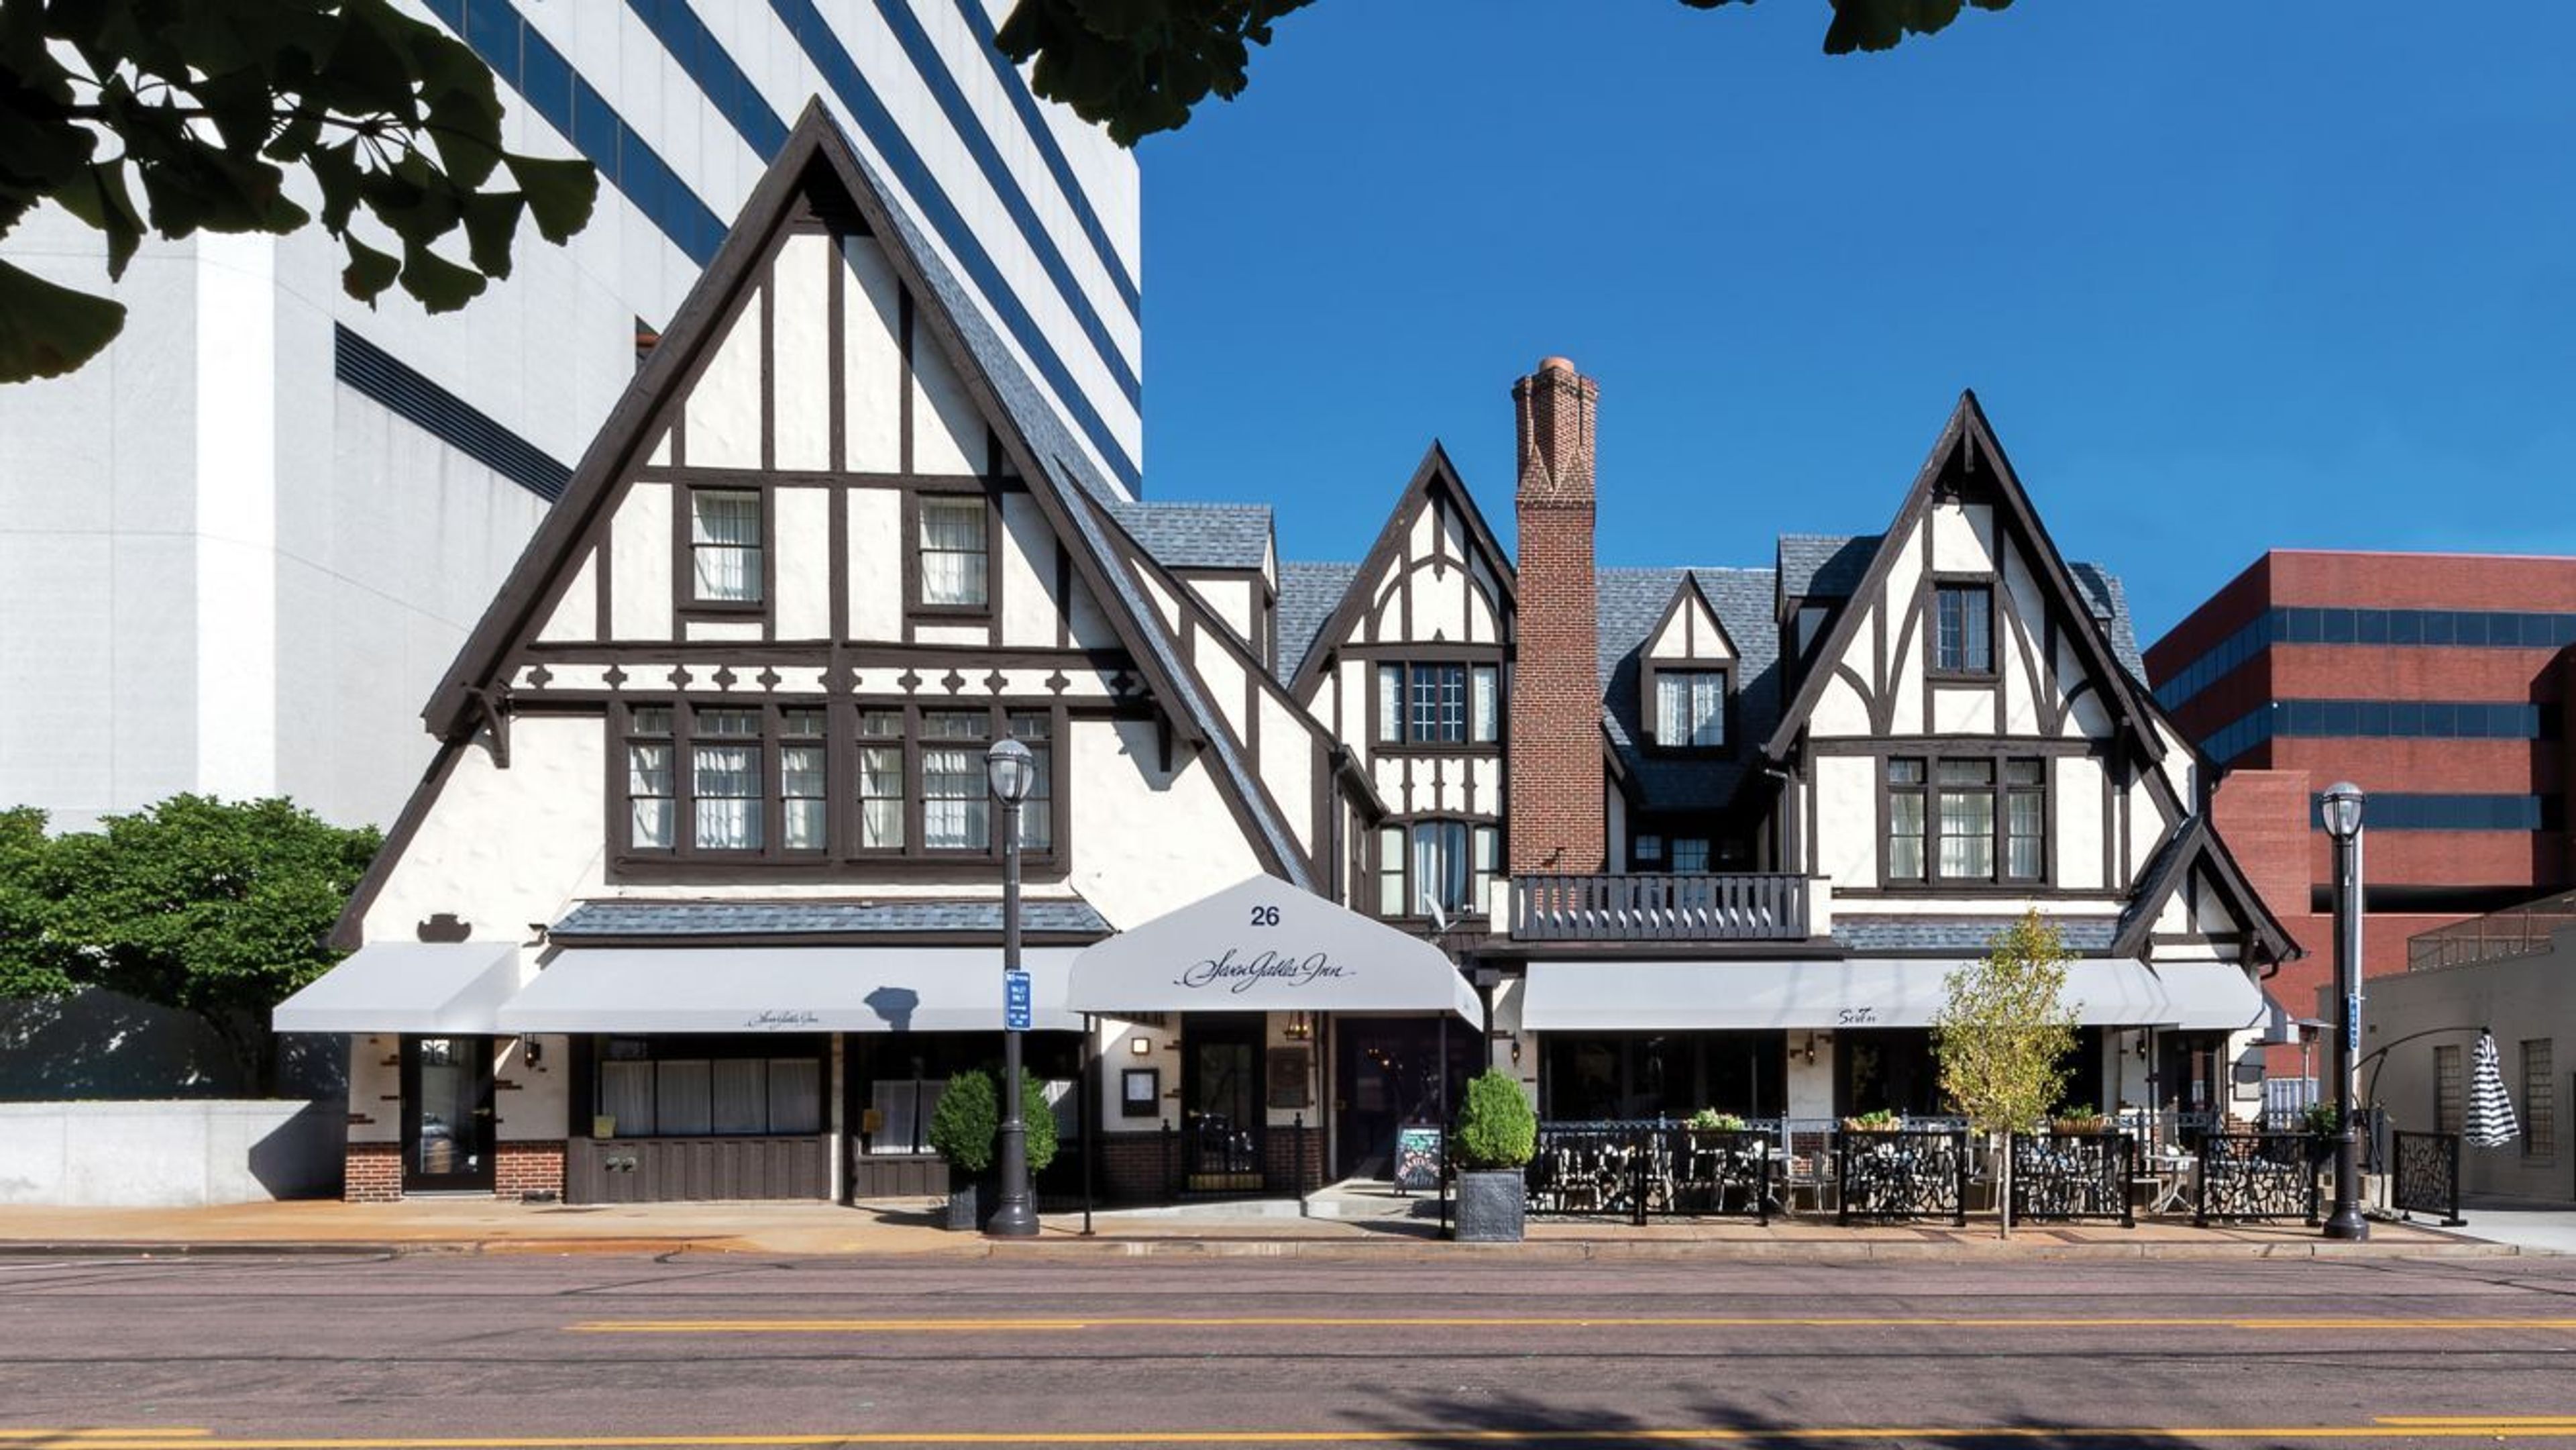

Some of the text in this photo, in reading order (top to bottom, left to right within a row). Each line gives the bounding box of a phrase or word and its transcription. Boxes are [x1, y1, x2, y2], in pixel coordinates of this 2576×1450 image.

[1250, 906, 1280, 927] 26
[1174, 948, 1356, 993] Seven Gables Inn
